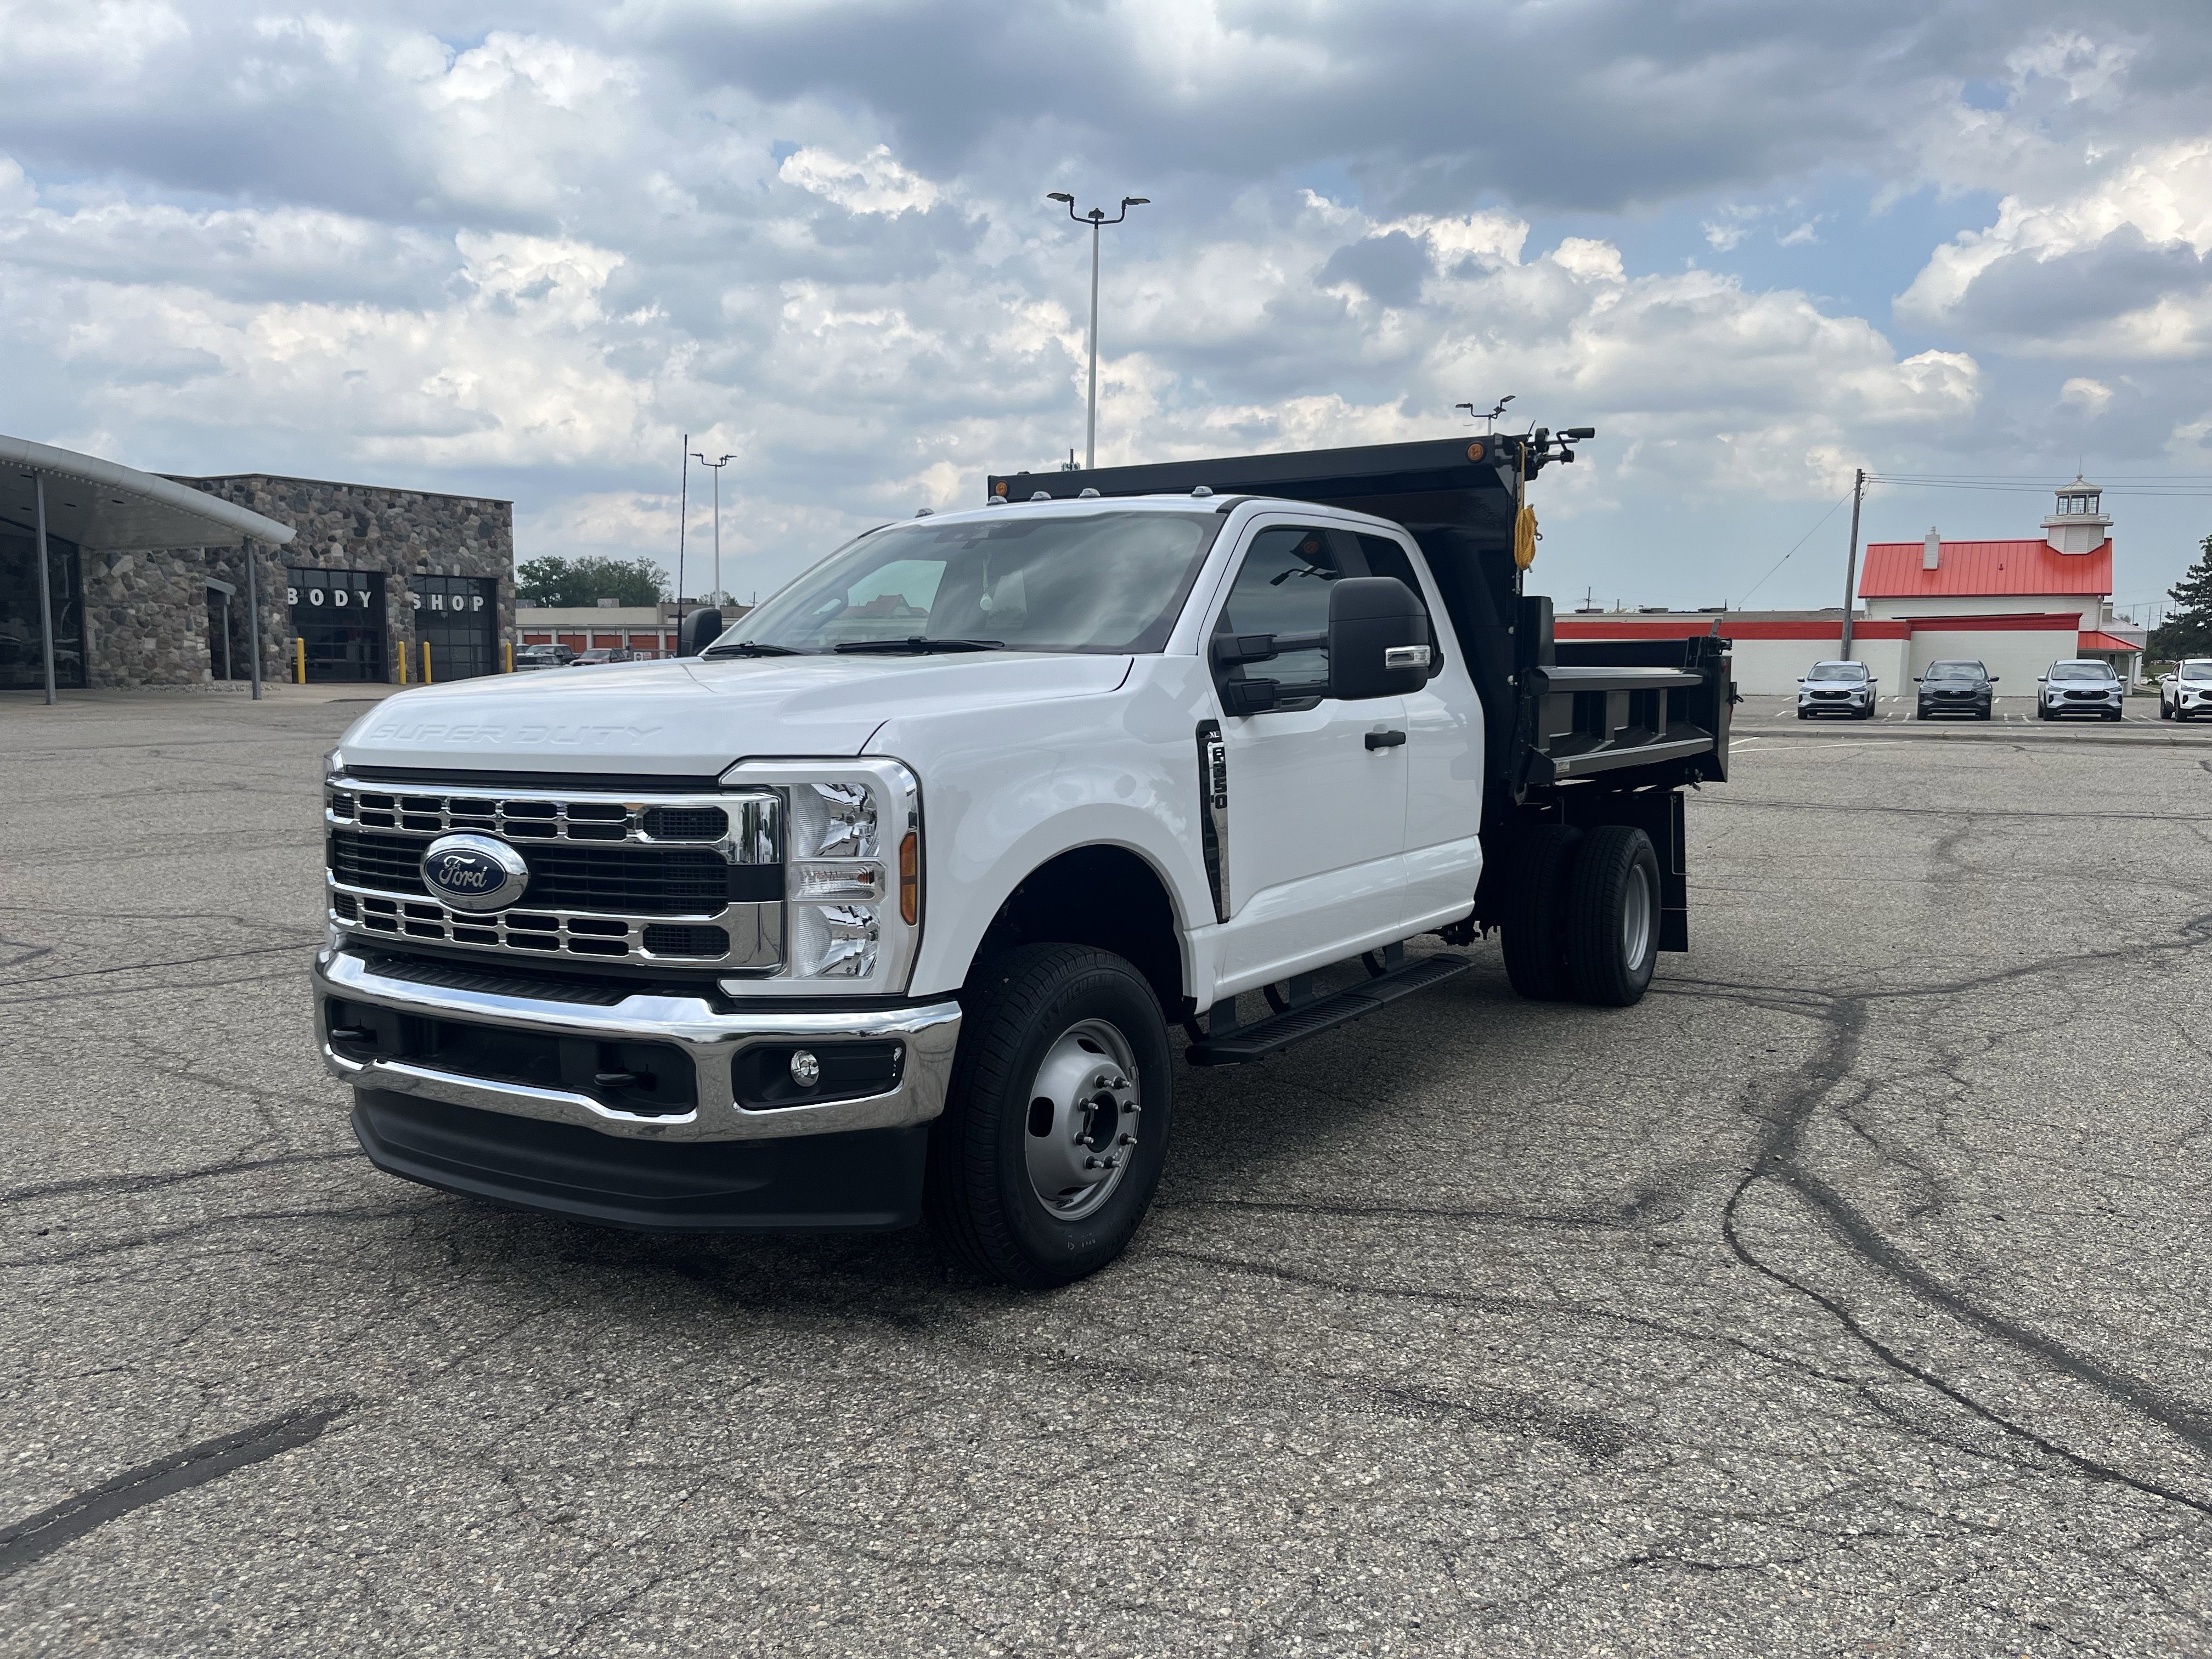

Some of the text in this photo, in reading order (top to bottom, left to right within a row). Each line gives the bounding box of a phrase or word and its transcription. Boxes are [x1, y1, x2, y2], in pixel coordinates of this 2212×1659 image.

[287, 588, 484, 612] BODY SHOP
[369, 724, 663, 746] SUPER DUTY
[439, 855, 488, 888] Ford
